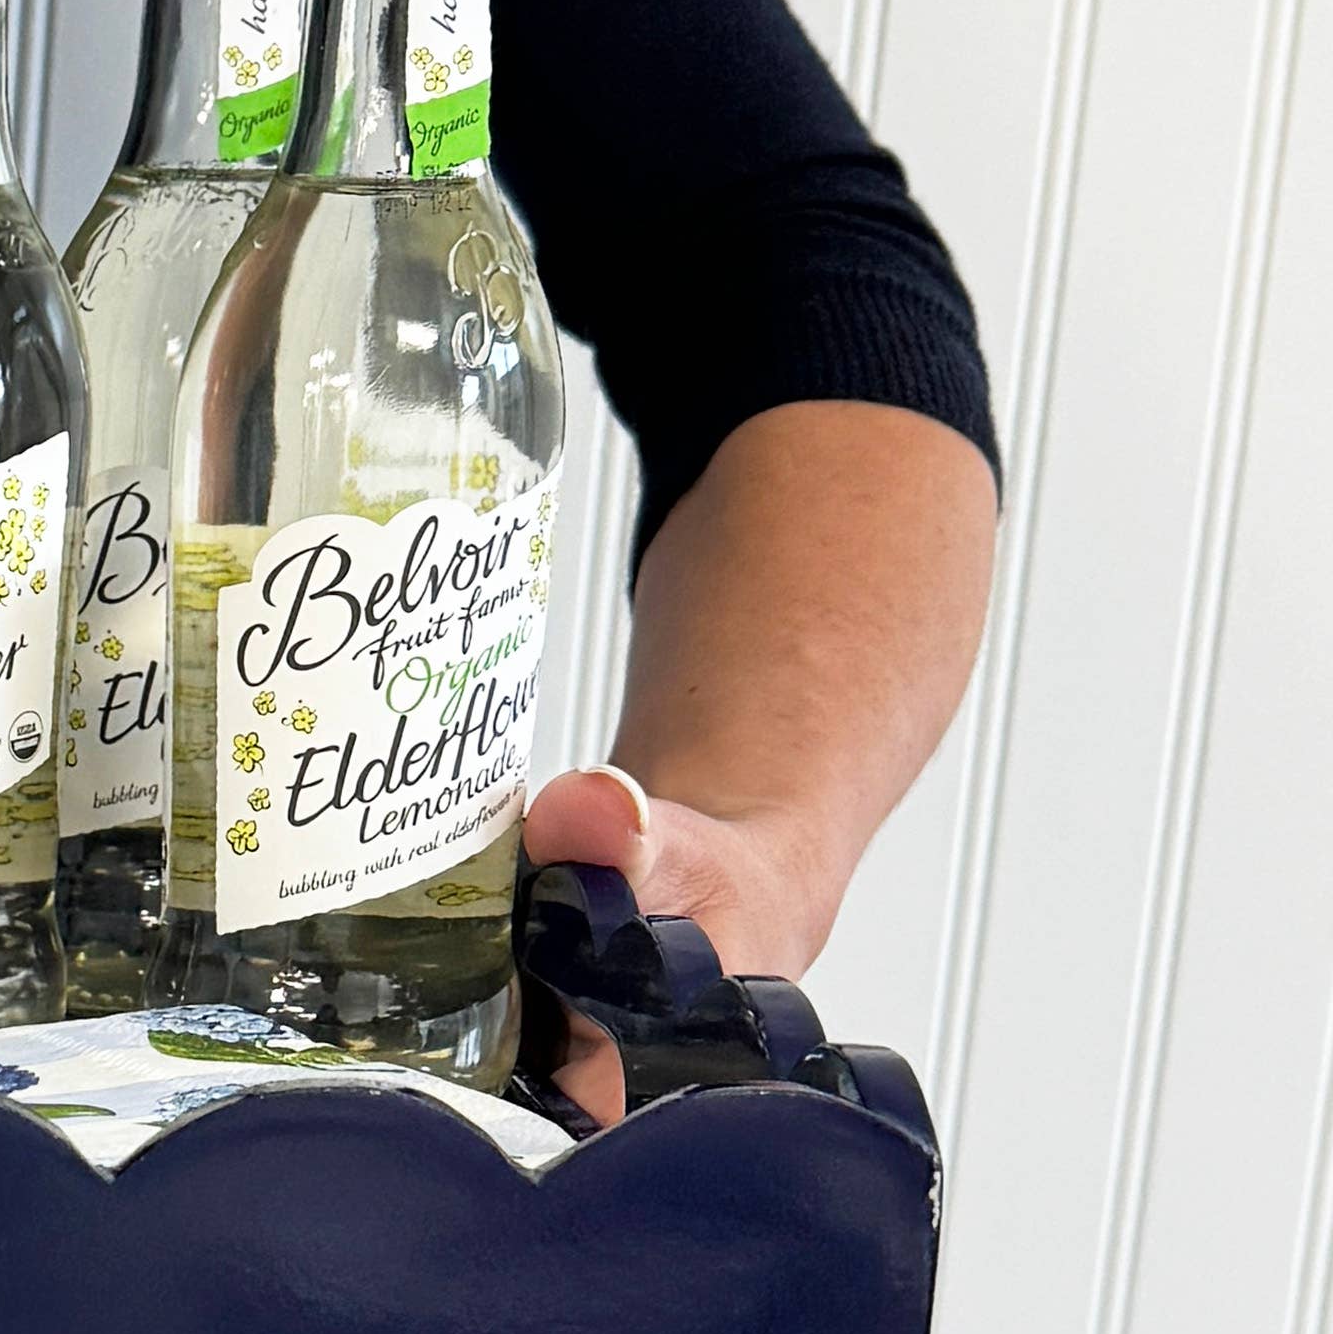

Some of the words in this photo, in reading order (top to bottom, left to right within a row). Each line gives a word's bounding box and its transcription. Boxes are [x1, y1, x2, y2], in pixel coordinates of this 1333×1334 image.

[219, 98, 290, 145] Organic
[237, 514, 530, 688] Belvoir
[352, 611, 454, 691] fruit
[385, 614, 533, 726] Organic
[93, 782, 159, 809] bubbling
[279, 867, 357, 899] bubbling
[365, 847, 404, 876] with
